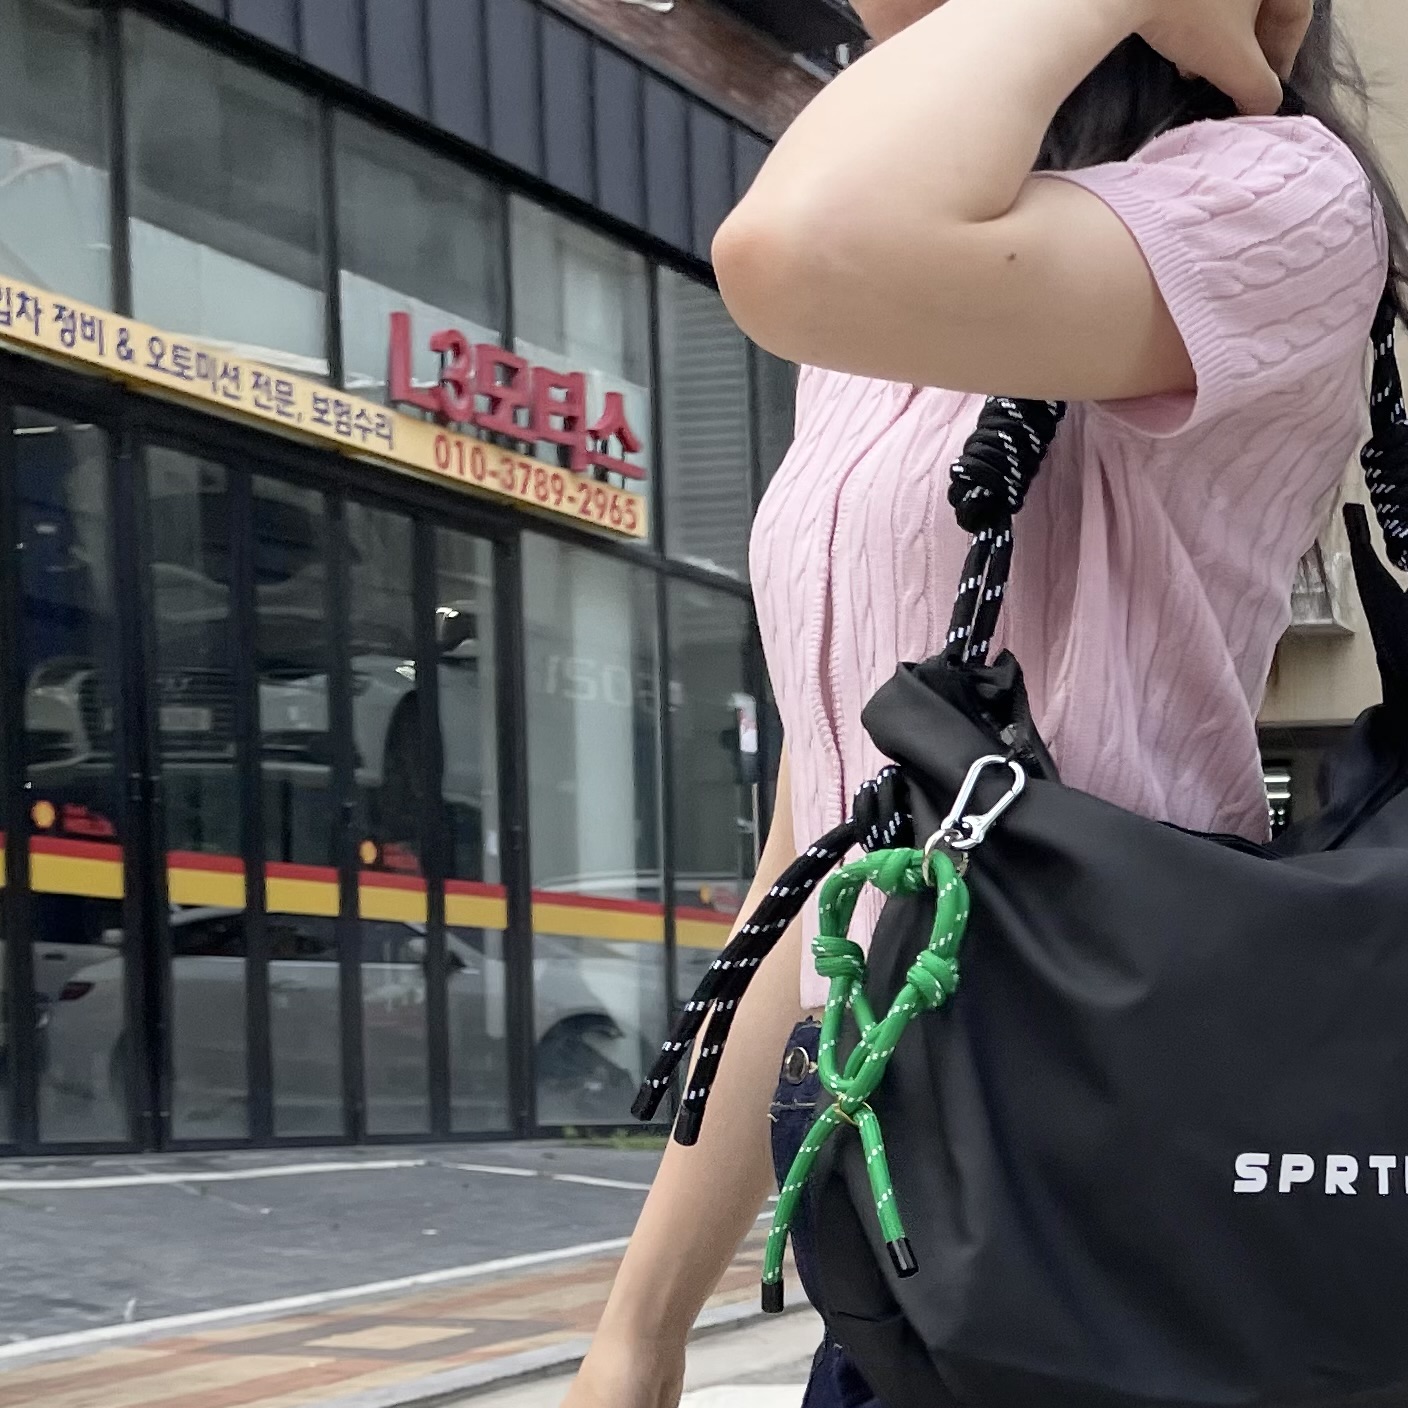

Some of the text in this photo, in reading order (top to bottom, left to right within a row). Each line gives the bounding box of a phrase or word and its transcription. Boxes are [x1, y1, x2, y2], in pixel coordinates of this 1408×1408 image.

[53, 303, 104, 356] 정비
[116, 327, 134, 361] &
[147, 335, 242, 400] 오토미션
[311, 392, 394, 450] 보험수리
[433, 433, 637, 531] 010-3789-2965
[389, 311, 648, 480] L3모터스
